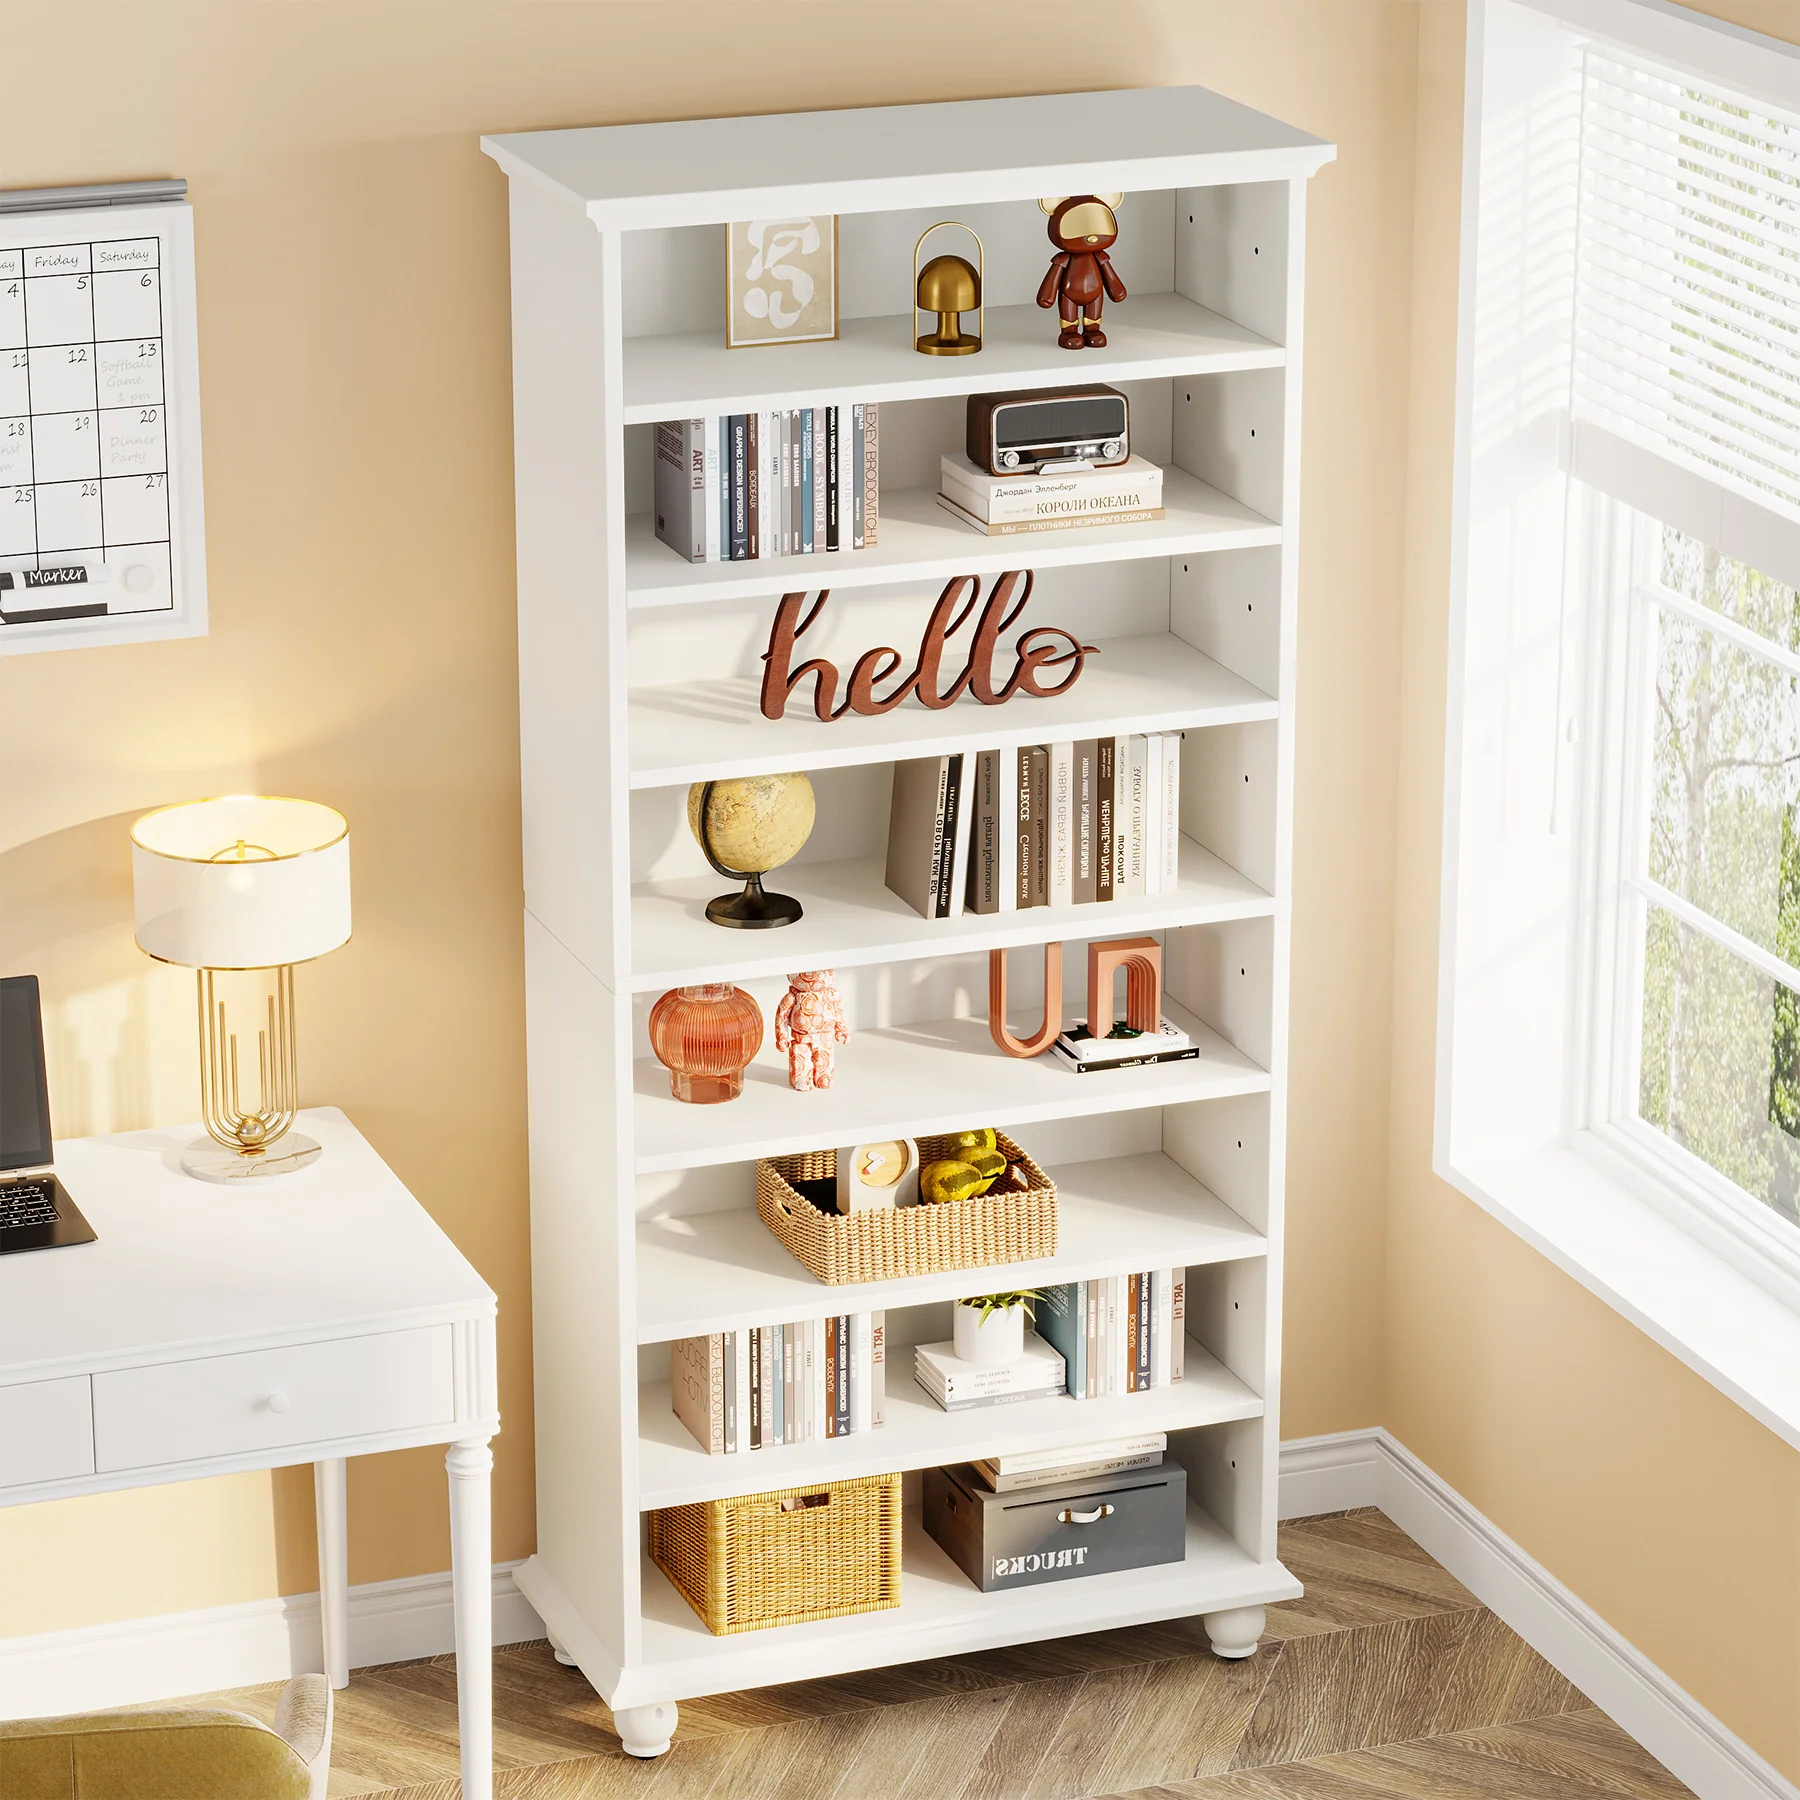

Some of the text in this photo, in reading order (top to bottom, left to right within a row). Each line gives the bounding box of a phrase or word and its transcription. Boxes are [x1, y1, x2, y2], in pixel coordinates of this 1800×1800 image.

[35, 256, 79, 268] Friday
[100, 249, 149, 263] Saturday
[76, 276, 89, 289] 5
[140, 273, 152, 287] 6
[7, 283, 19, 298] 4
[68, 349, 87, 364] 12
[138, 343, 157, 358] 13
[12, 353, 29, 368] 11
[100, 358, 153, 373] Softball
[106, 376, 144, 388] Game
[117, 393, 152, 406] 1 pm
[75, 416, 90, 431] 19
[140, 409, 157, 424] 20
[8, 422, 25, 437] 18
[0, 443, 22, 455] tist
[110, 436, 156, 447] Dinner
[815, 433, 824, 464] BOOK
[111, 452, 146, 464] Party
[693, 450, 703, 472] ART
[707, 448, 717, 472] ART
[736, 459, 744, 486] DESIGN
[866, 403, 877, 537] LEXEY BRODOVITCH
[145, 475, 163, 489] 27
[749, 470, 757, 509] BORDEAUX
[15, 489, 33, 503] 25
[81, 483, 97, 497] 26
[995, 483, 1077, 498] Джордан Элленберг
[736, 487, 744, 533] REFERENCED
[815, 476, 824, 532] SYMBOLS
[1037, 494, 1140, 514] КОРОЛИ ОКЕАНА
[1002, 526, 1016, 534] МЫ
[1030, 520, 1071, 531] ПЛОТНИКИ
[1073, 516, 1120, 527] НЕЗРИМОГО
[1122, 512, 1153, 523] СОБОРА
[29, 568, 84, 585] Marker
[760, 569, 1101, 722] hello
[994, 1395, 1026, 1404] BORDEAUX
